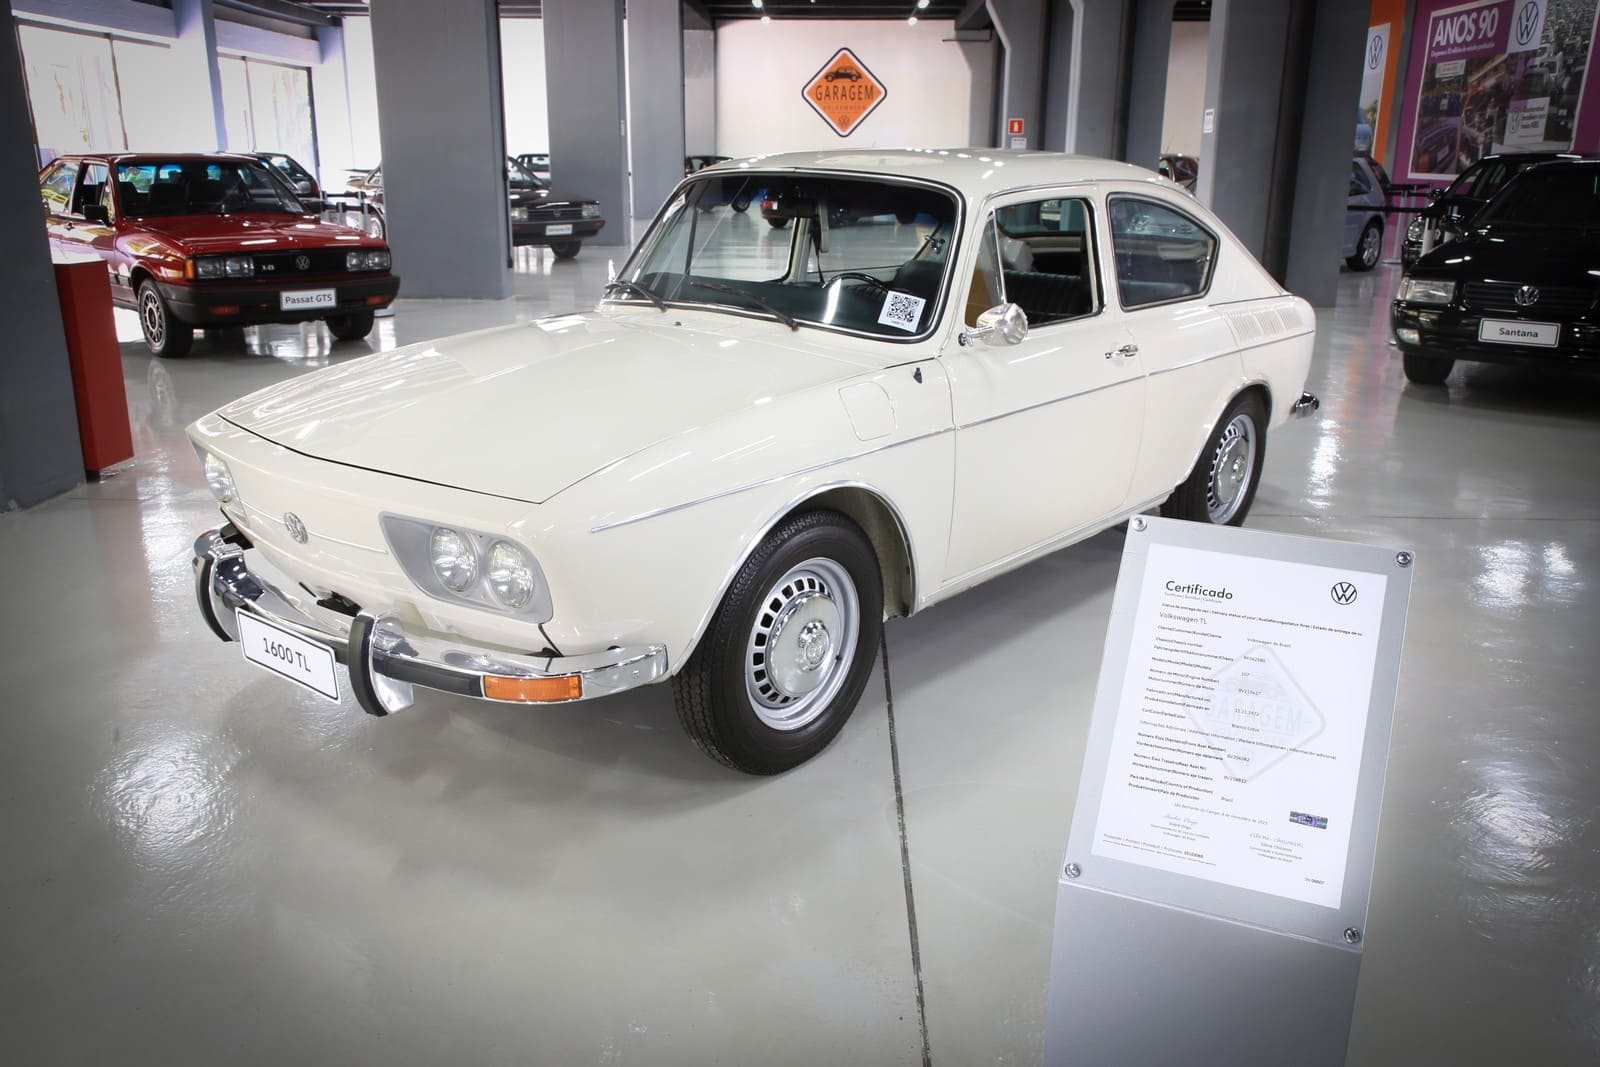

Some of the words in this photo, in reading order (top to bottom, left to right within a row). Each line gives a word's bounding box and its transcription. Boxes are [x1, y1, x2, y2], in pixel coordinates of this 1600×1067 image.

[1432, 12, 1477, 48] ANOS
[1479, 8, 1499, 39] 90
[815, 84, 874, 102] GARAGEM
[285, 295, 314, 305] Passat
[315, 293, 333, 303] GTS
[1499, 327, 1539, 339] Santana
[1165, 579, 1233, 599] Certificado
[1158, 611, 1198, 624] Volkswagen
[1198, 617, 1207, 625] TL
[263, 637, 294, 664] 1600
[295, 651, 311, 673] TL
